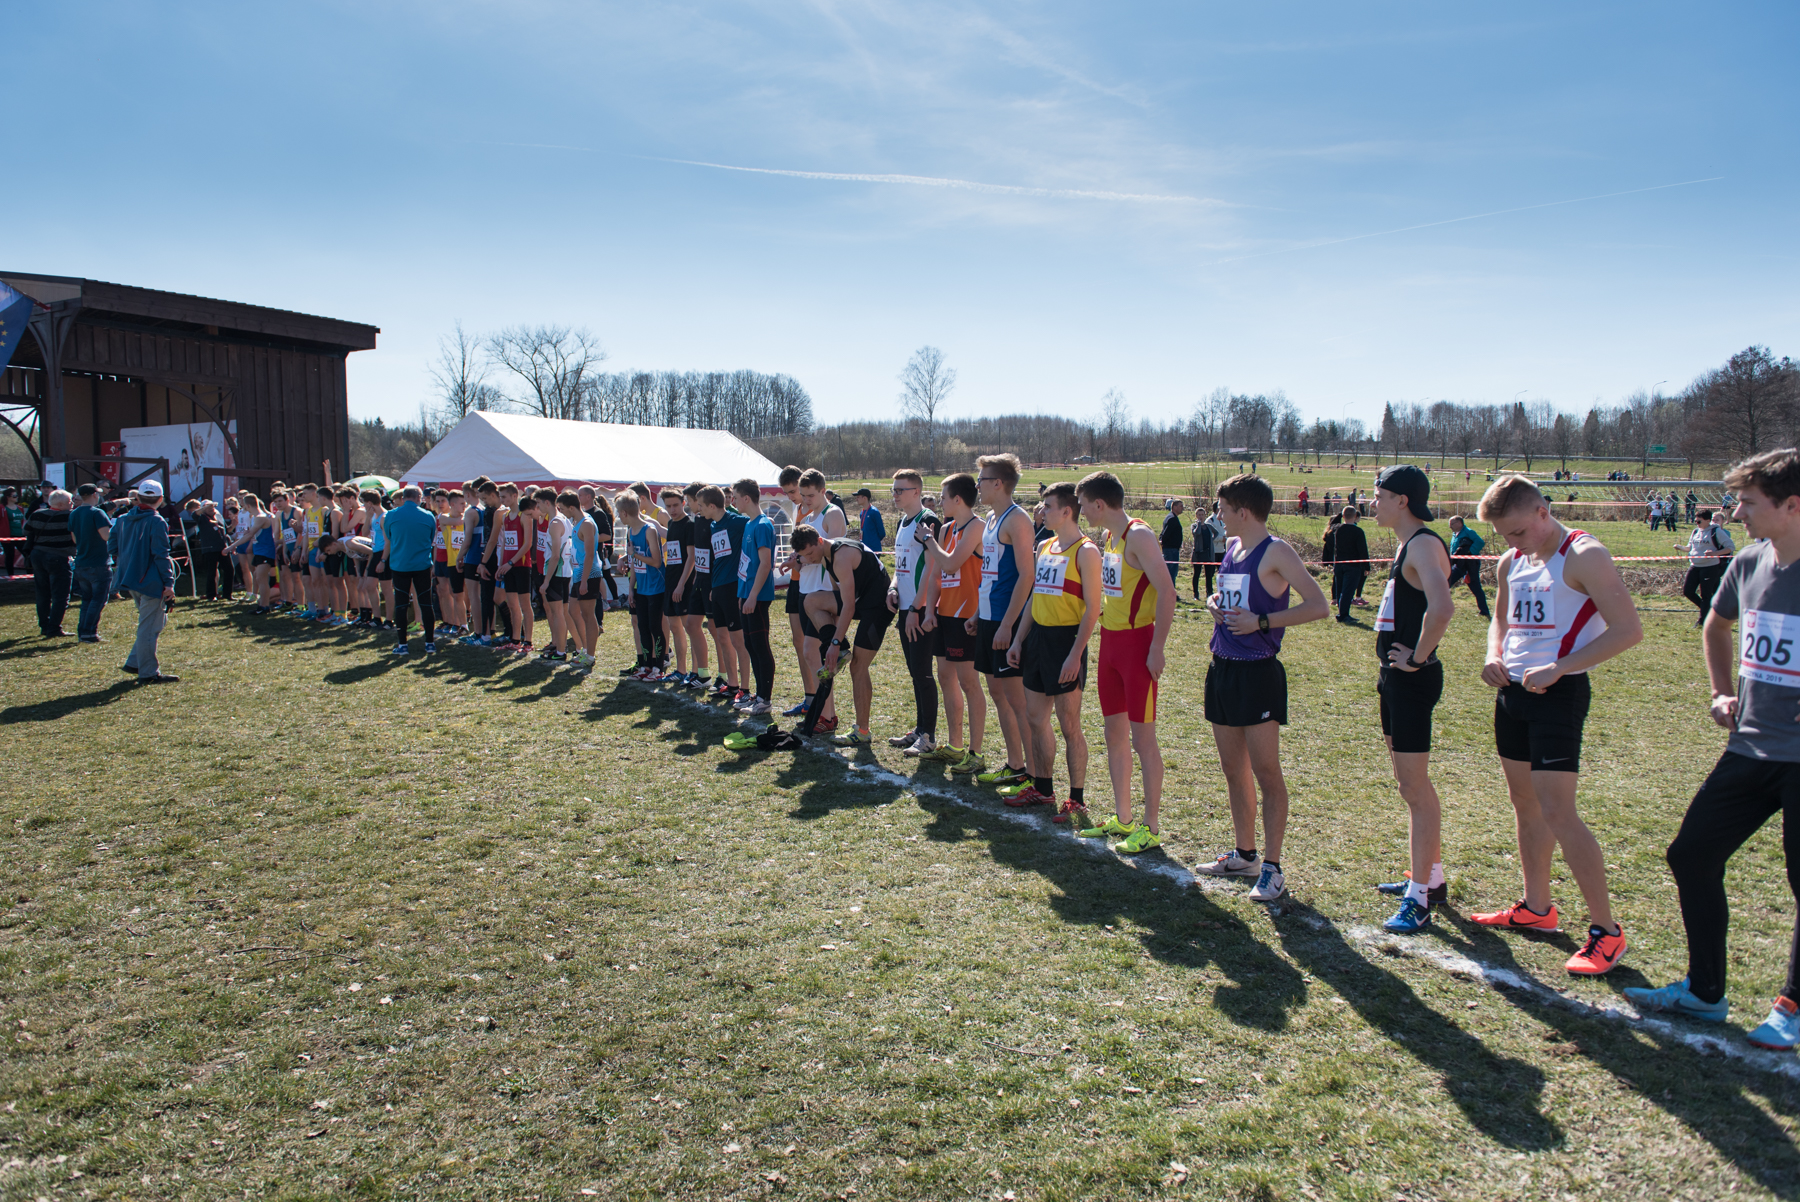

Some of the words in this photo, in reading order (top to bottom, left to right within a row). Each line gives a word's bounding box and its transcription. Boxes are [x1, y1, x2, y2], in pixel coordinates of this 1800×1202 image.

[1036, 567, 1058, 584] 541
[1219, 590, 1242, 609] 212
[1512, 600, 1546, 623] 413
[1744, 632, 1794, 666] 205
[1765, 674, 1783, 683] 2019
